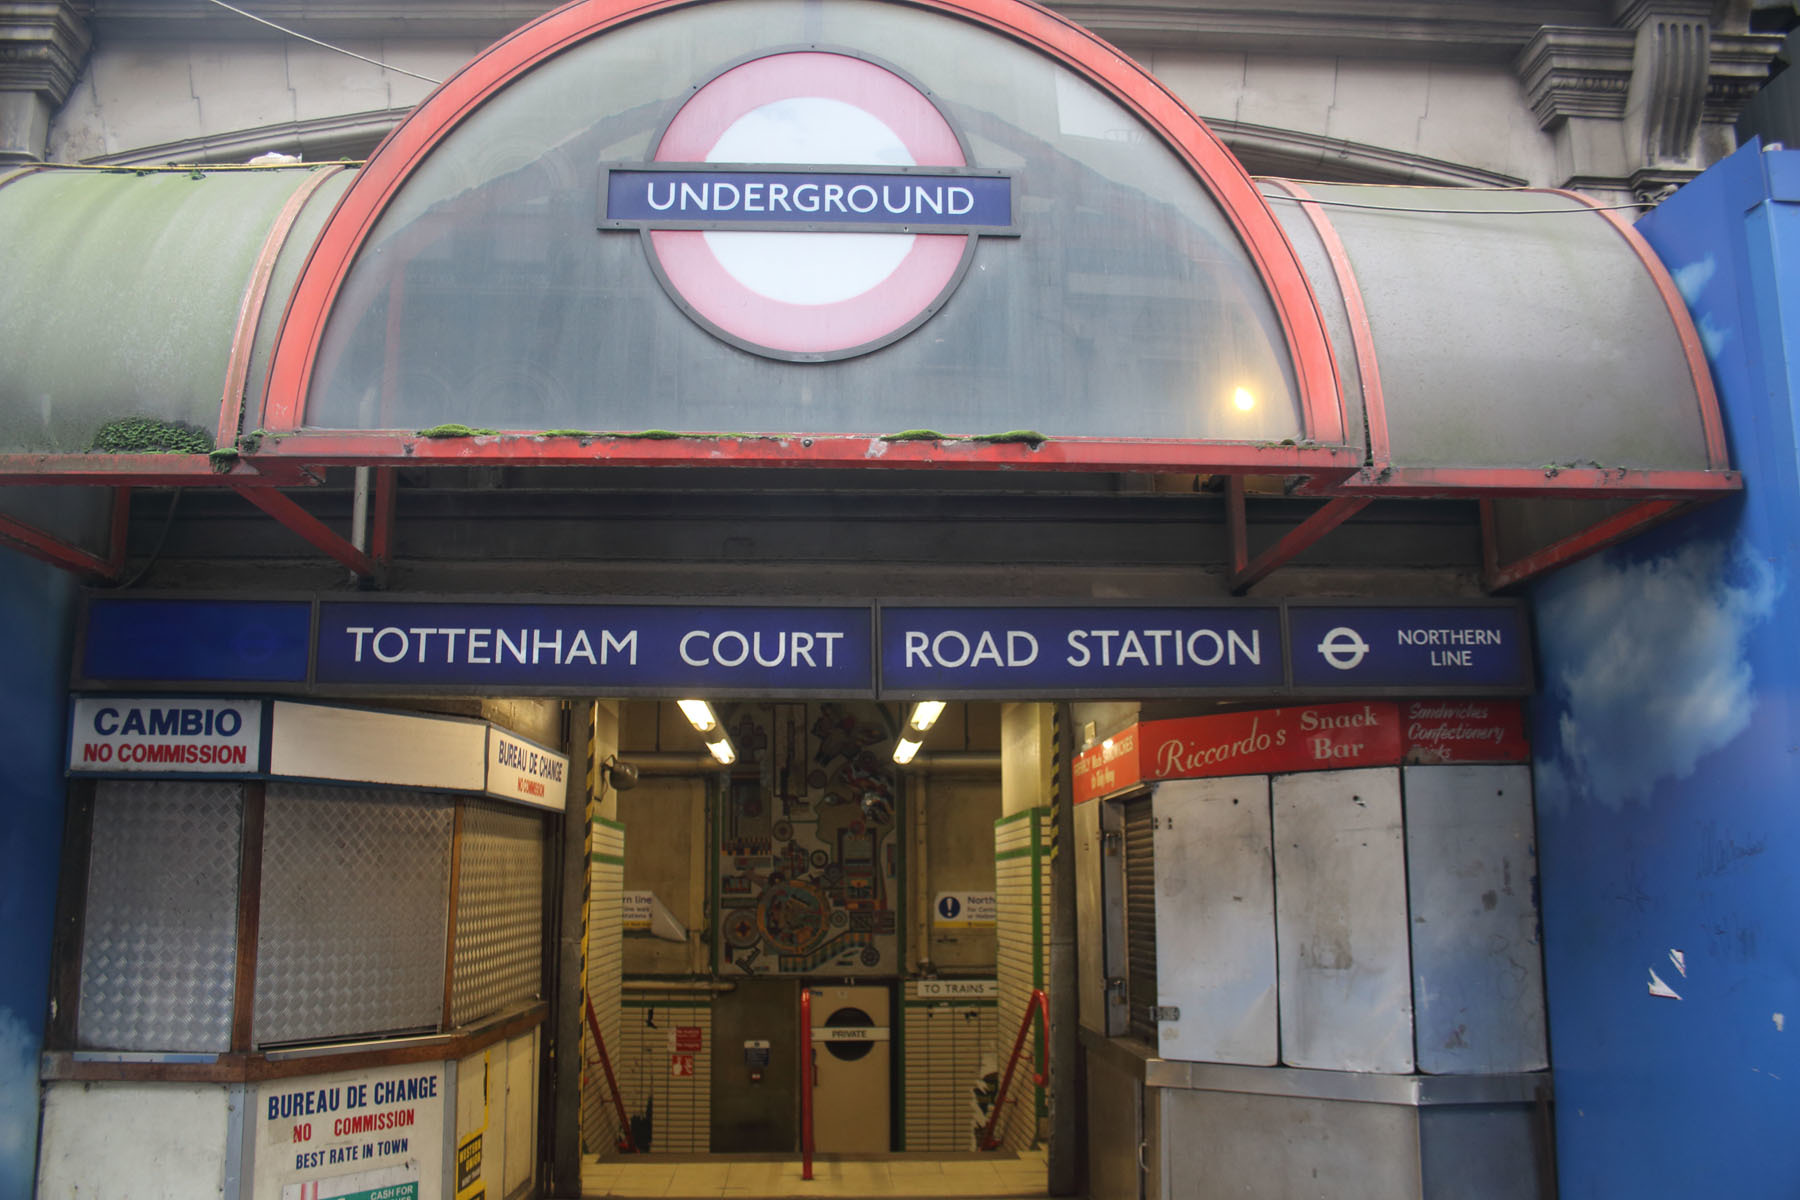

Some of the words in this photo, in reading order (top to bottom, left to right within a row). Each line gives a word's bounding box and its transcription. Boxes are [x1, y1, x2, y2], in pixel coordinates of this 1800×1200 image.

[647, 182, 975, 215] UNDERGROUND
[346, 627, 638, 666] TOTTENHAM
[679, 630, 844, 668] COURT
[905, 631, 1039, 668] ROAD
[1066, 629, 1261, 667] STATION
[1398, 629, 1501, 646] NORTHERN
[1431, 651, 1473, 667] LINE
[94, 707, 242, 737] CAMBIO
[1301, 706, 1378, 731] Snack
[1408, 702, 1488, 720] Sandwiches
[1155, 709, 1287, 777] Riccardo's
[1408, 722, 1504, 744] Confectionery
[83, 743, 113, 762] NO
[118, 743, 247, 764] COMMISSION
[1315, 738, 1364, 759] Bar
[1410, 744, 1452, 759] inks
[498, 740, 528, 772] BUREAU
[529, 752, 538, 775] DE
[539, 755, 563, 783] CHANGE
[924, 984, 940, 993] TO
[944, 984, 984, 993] TRAINS
[831, 1030, 867, 1038] PRIVATE
[268, 1086, 340, 1120] BUREAU
[347, 1084, 367, 1110] DE
[374, 1075, 437, 1106] CHANGE
[293, 1123, 312, 1143] NO
[334, 1108, 415, 1137] COMMISSION
[296, 1150, 325, 1170] BEST
[329, 1145, 358, 1163] RATE
[362, 1143, 373, 1159] IN
[378, 1138, 408, 1156] TOWN
[370, 1190, 394, 1200] CASH
[396, 1185, 413, 1196] FOR
